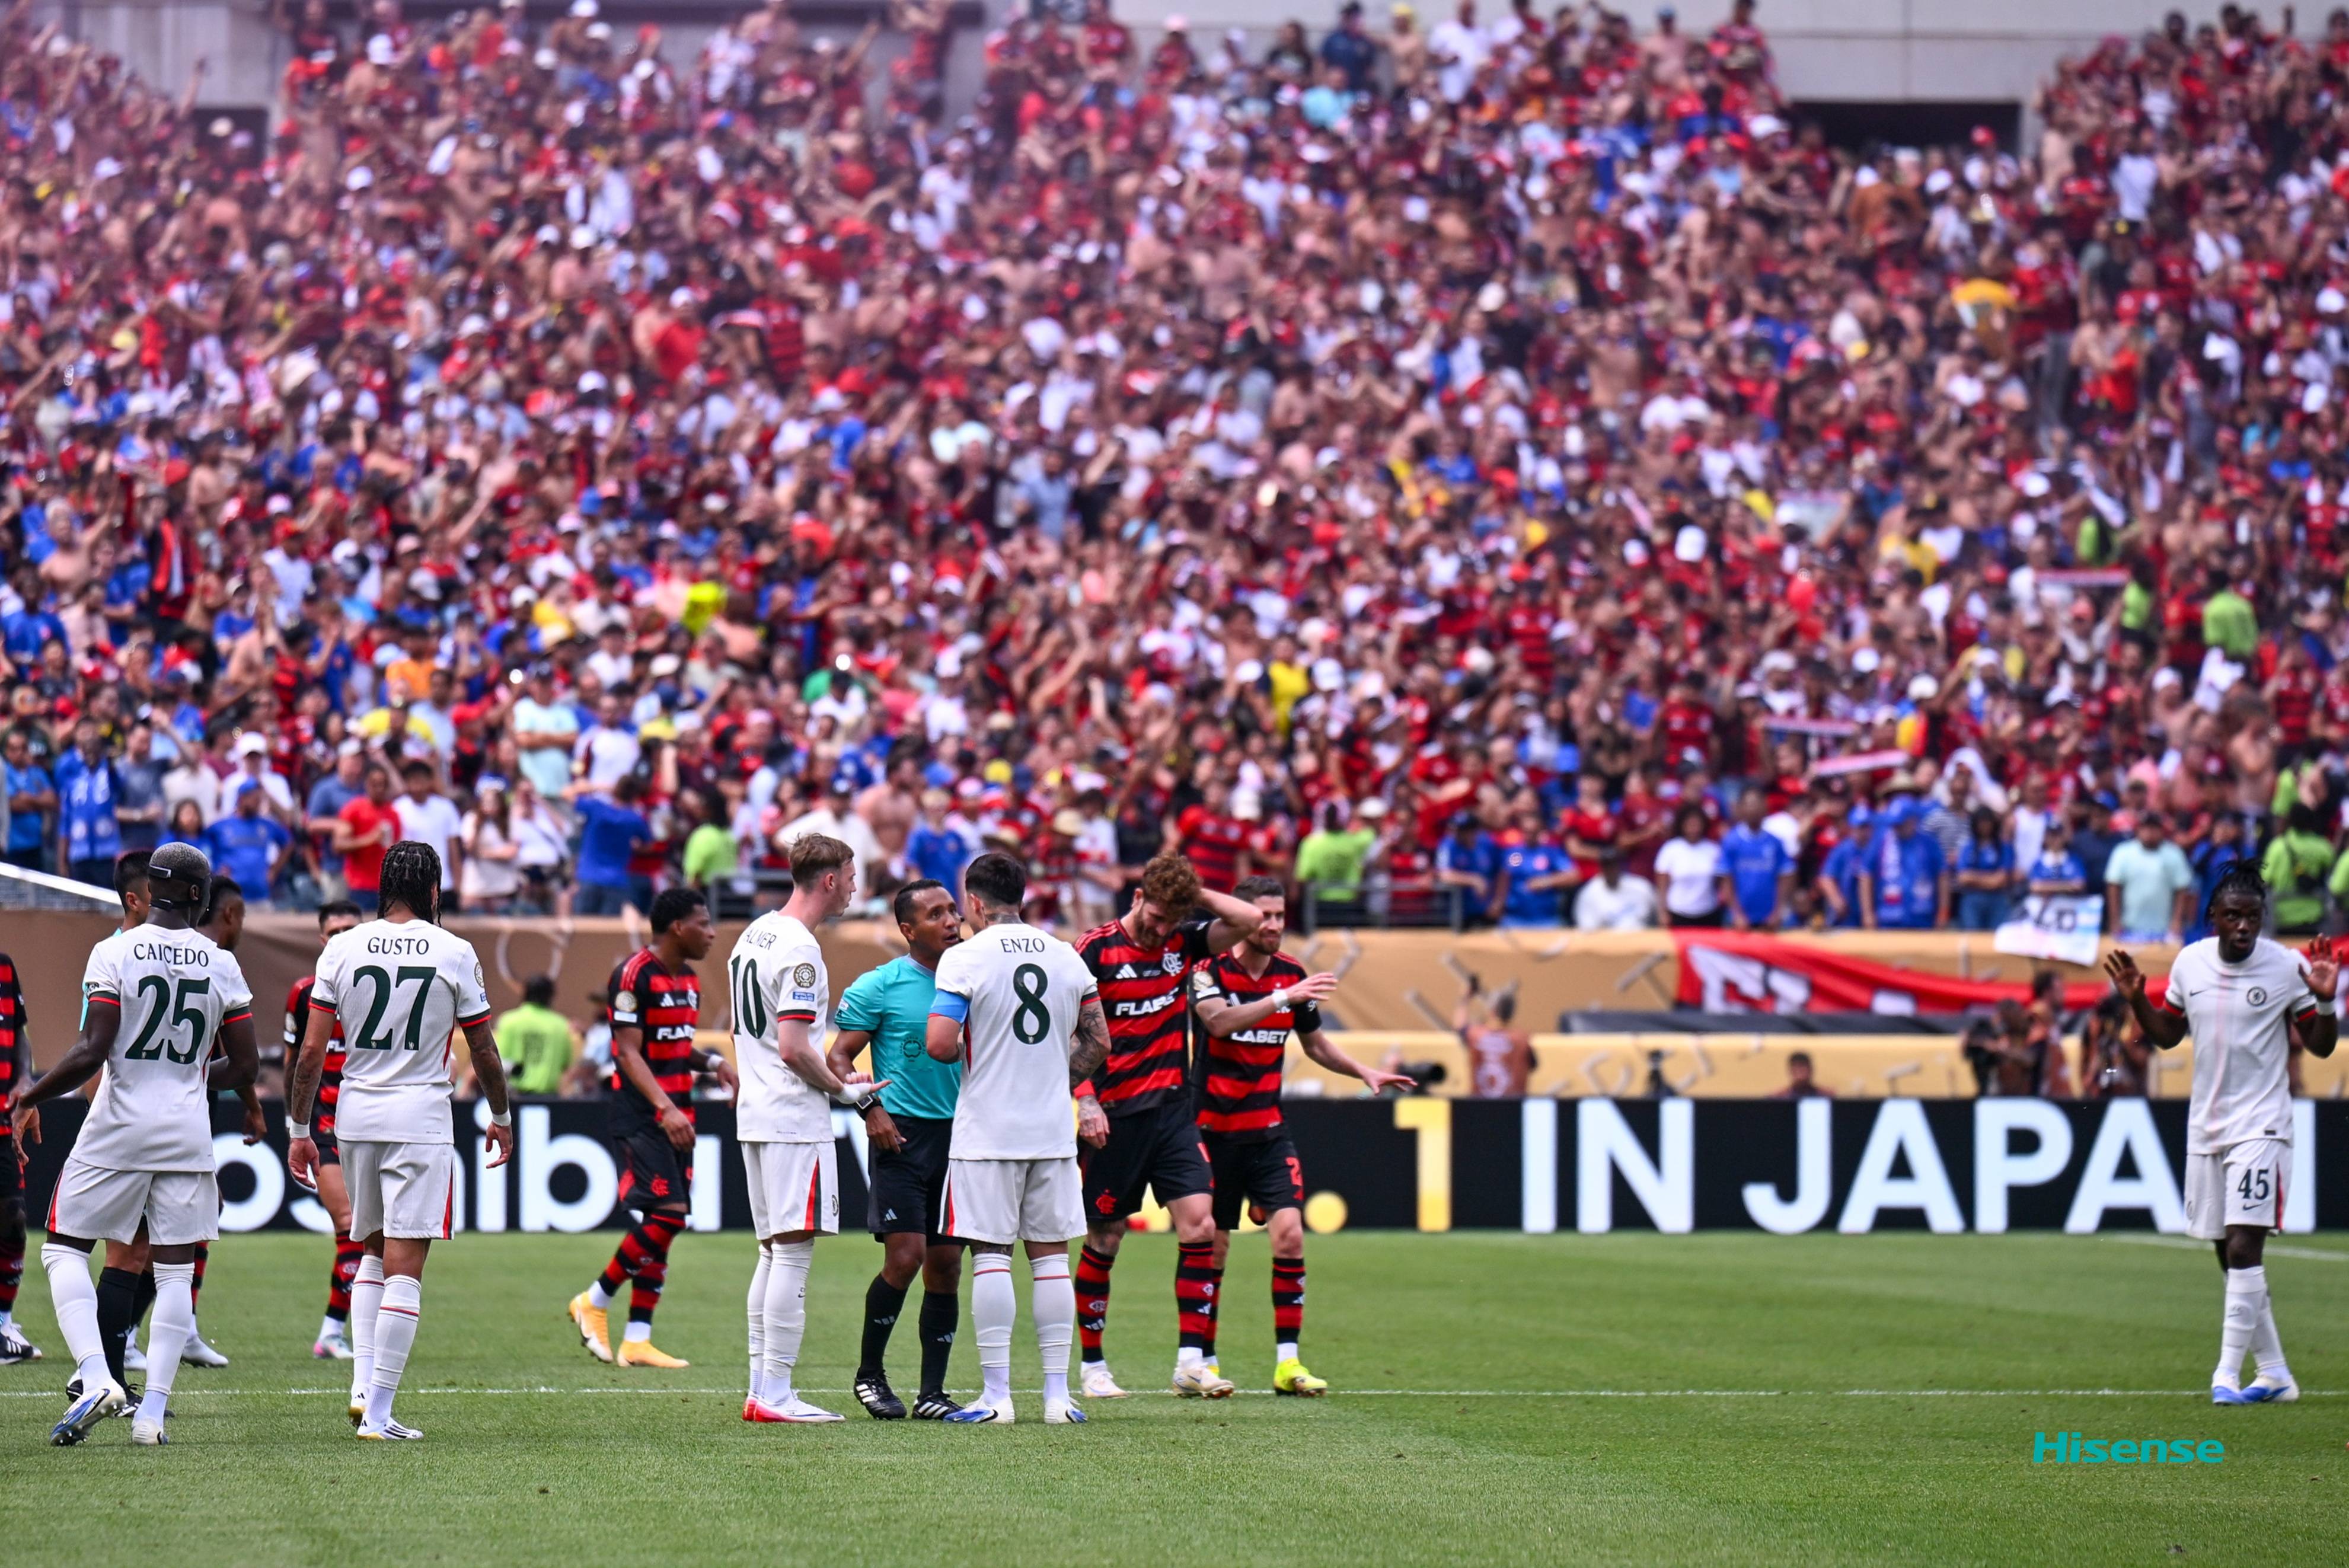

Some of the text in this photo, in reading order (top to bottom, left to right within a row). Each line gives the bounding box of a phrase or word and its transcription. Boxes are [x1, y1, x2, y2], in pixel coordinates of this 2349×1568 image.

[134, 943, 209, 967] CAICEDO
[368, 937, 429, 955] GUSTO
[742, 926, 777, 950] ALMER
[1000, 938, 1045, 953] ENZO
[125, 975, 210, 1064] 25
[353, 965, 436, 1050] 27
[731, 954, 767, 1039] 10
[1013, 963, 1051, 1045] 8
[1522, 1097, 1694, 1233] IN
[2237, 1168, 2270, 1200] 45
